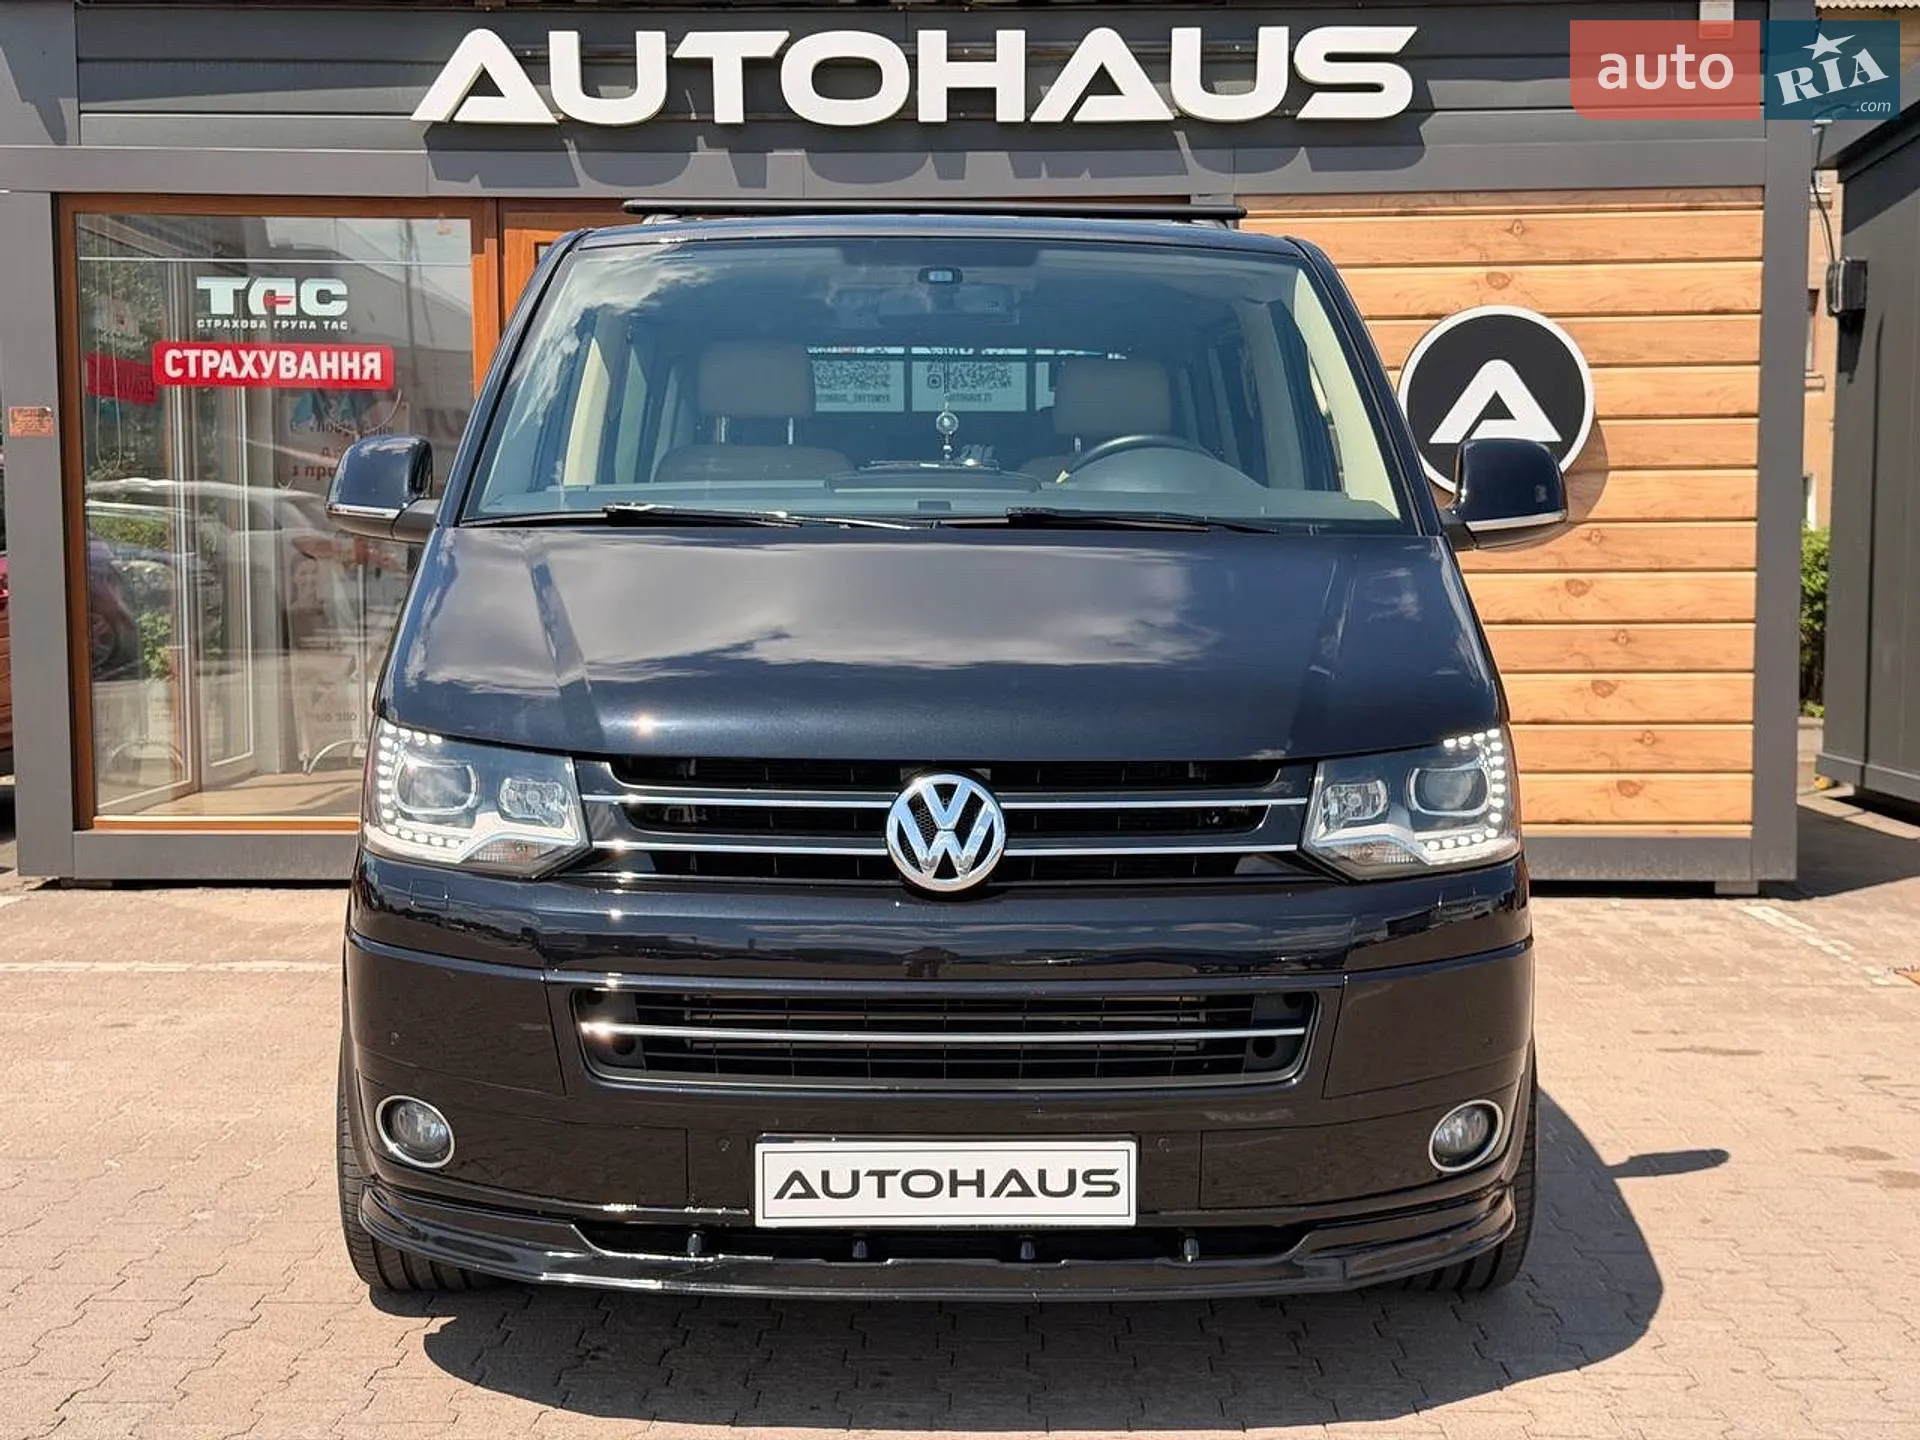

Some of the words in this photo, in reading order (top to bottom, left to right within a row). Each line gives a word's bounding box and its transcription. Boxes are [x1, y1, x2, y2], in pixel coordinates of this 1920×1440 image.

[410, 25, 1418, 127] AUTOHAUS
[196, 319, 267, 330] СТРАХОВА
[273, 320, 317, 330] ГРУПА
[323, 320, 348, 330] ТАС
[164, 349, 382, 381] СТРАХУВАННЯ
[773, 1168, 1121, 1200] AUTOHAUS
